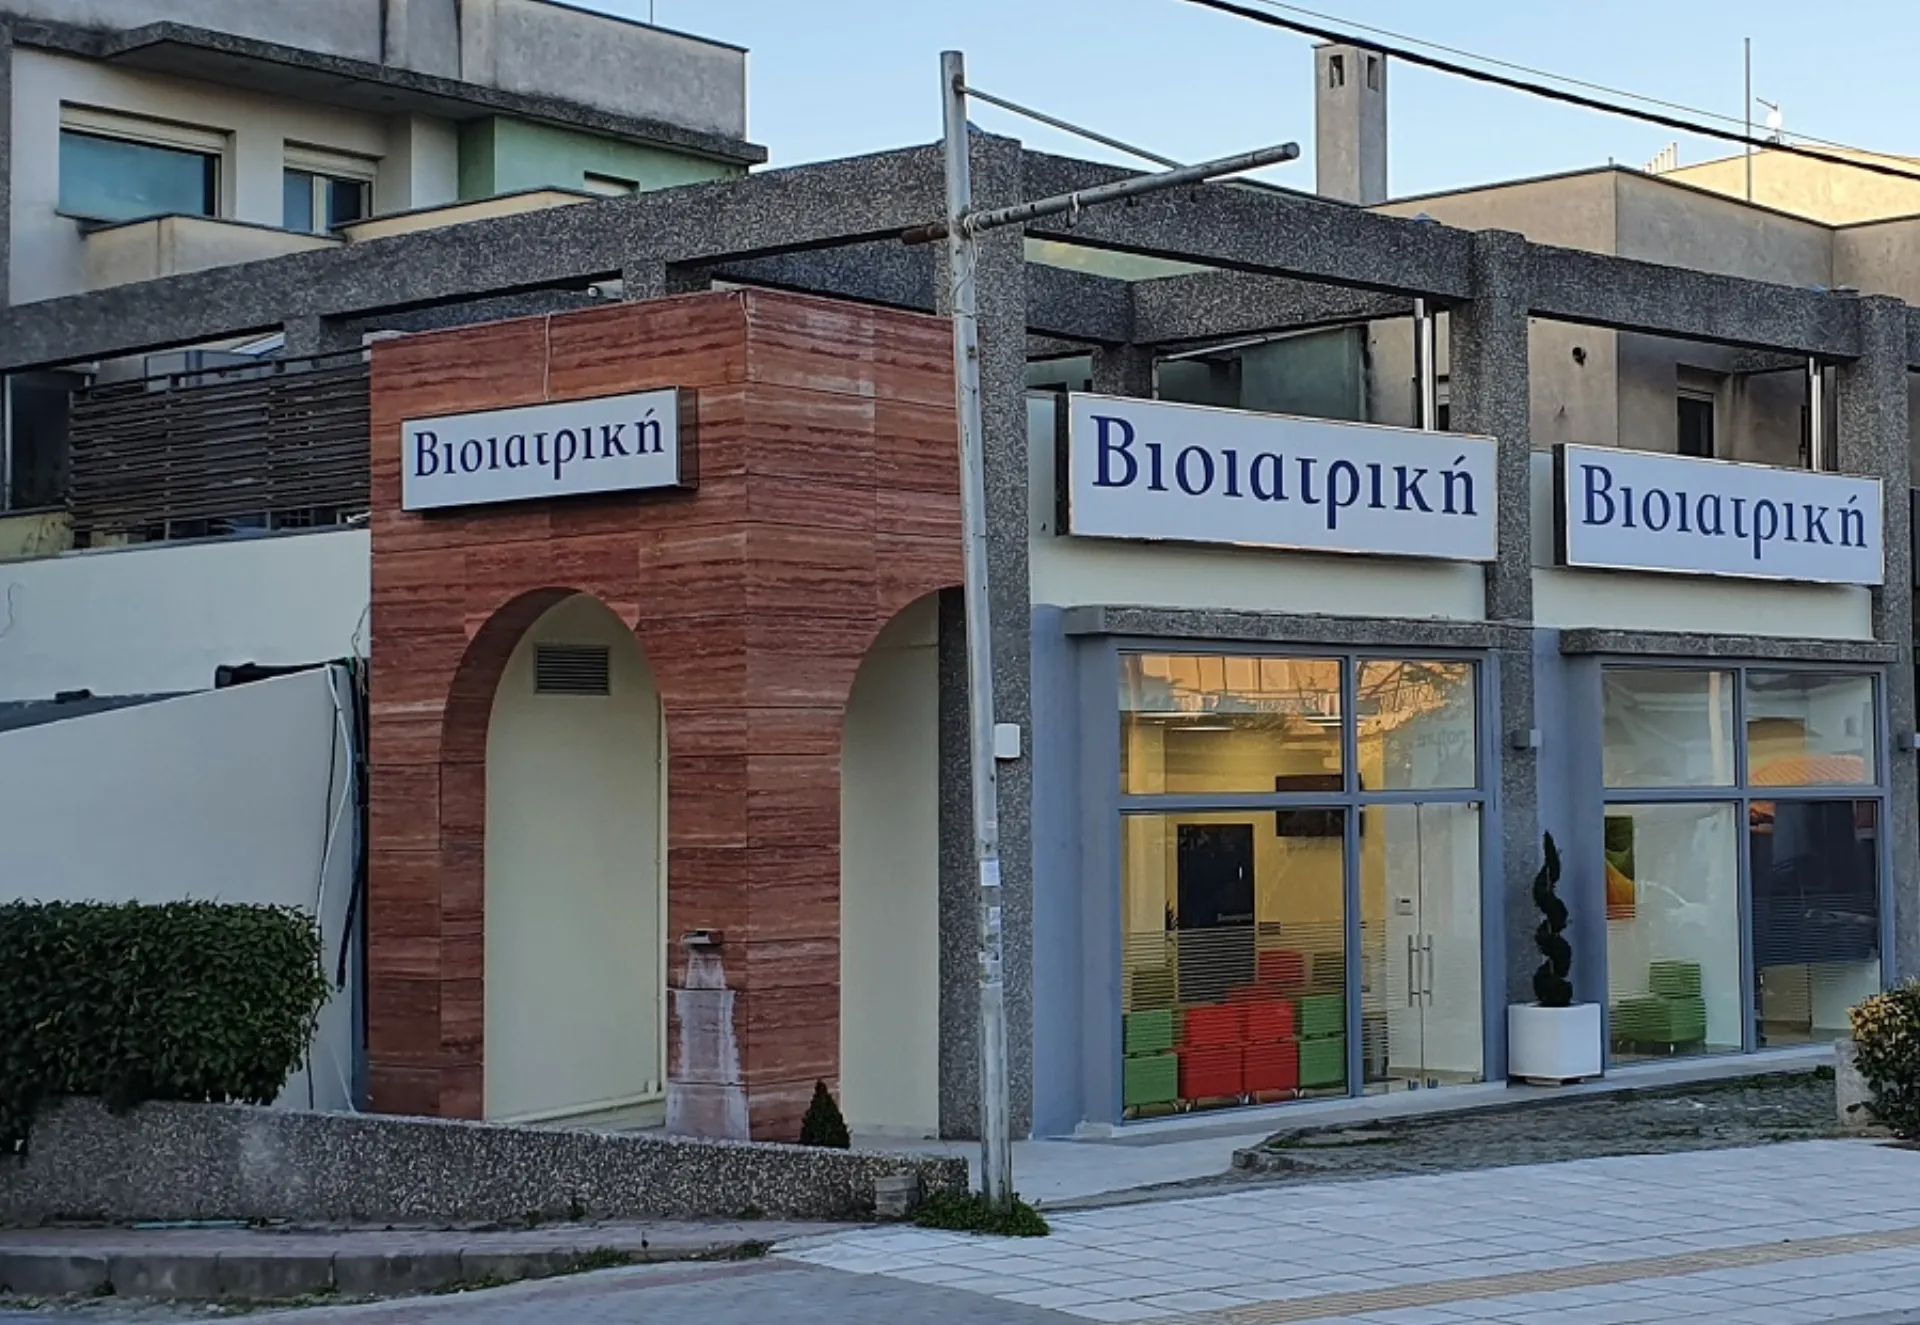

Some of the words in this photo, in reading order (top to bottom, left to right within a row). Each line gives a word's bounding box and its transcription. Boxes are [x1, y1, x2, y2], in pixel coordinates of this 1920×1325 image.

[414, 407, 665, 478] Βιοιατρική
[1090, 415, 1478, 529] Βιοιατρική
[1580, 464, 1868, 560] Βιοιατρική
